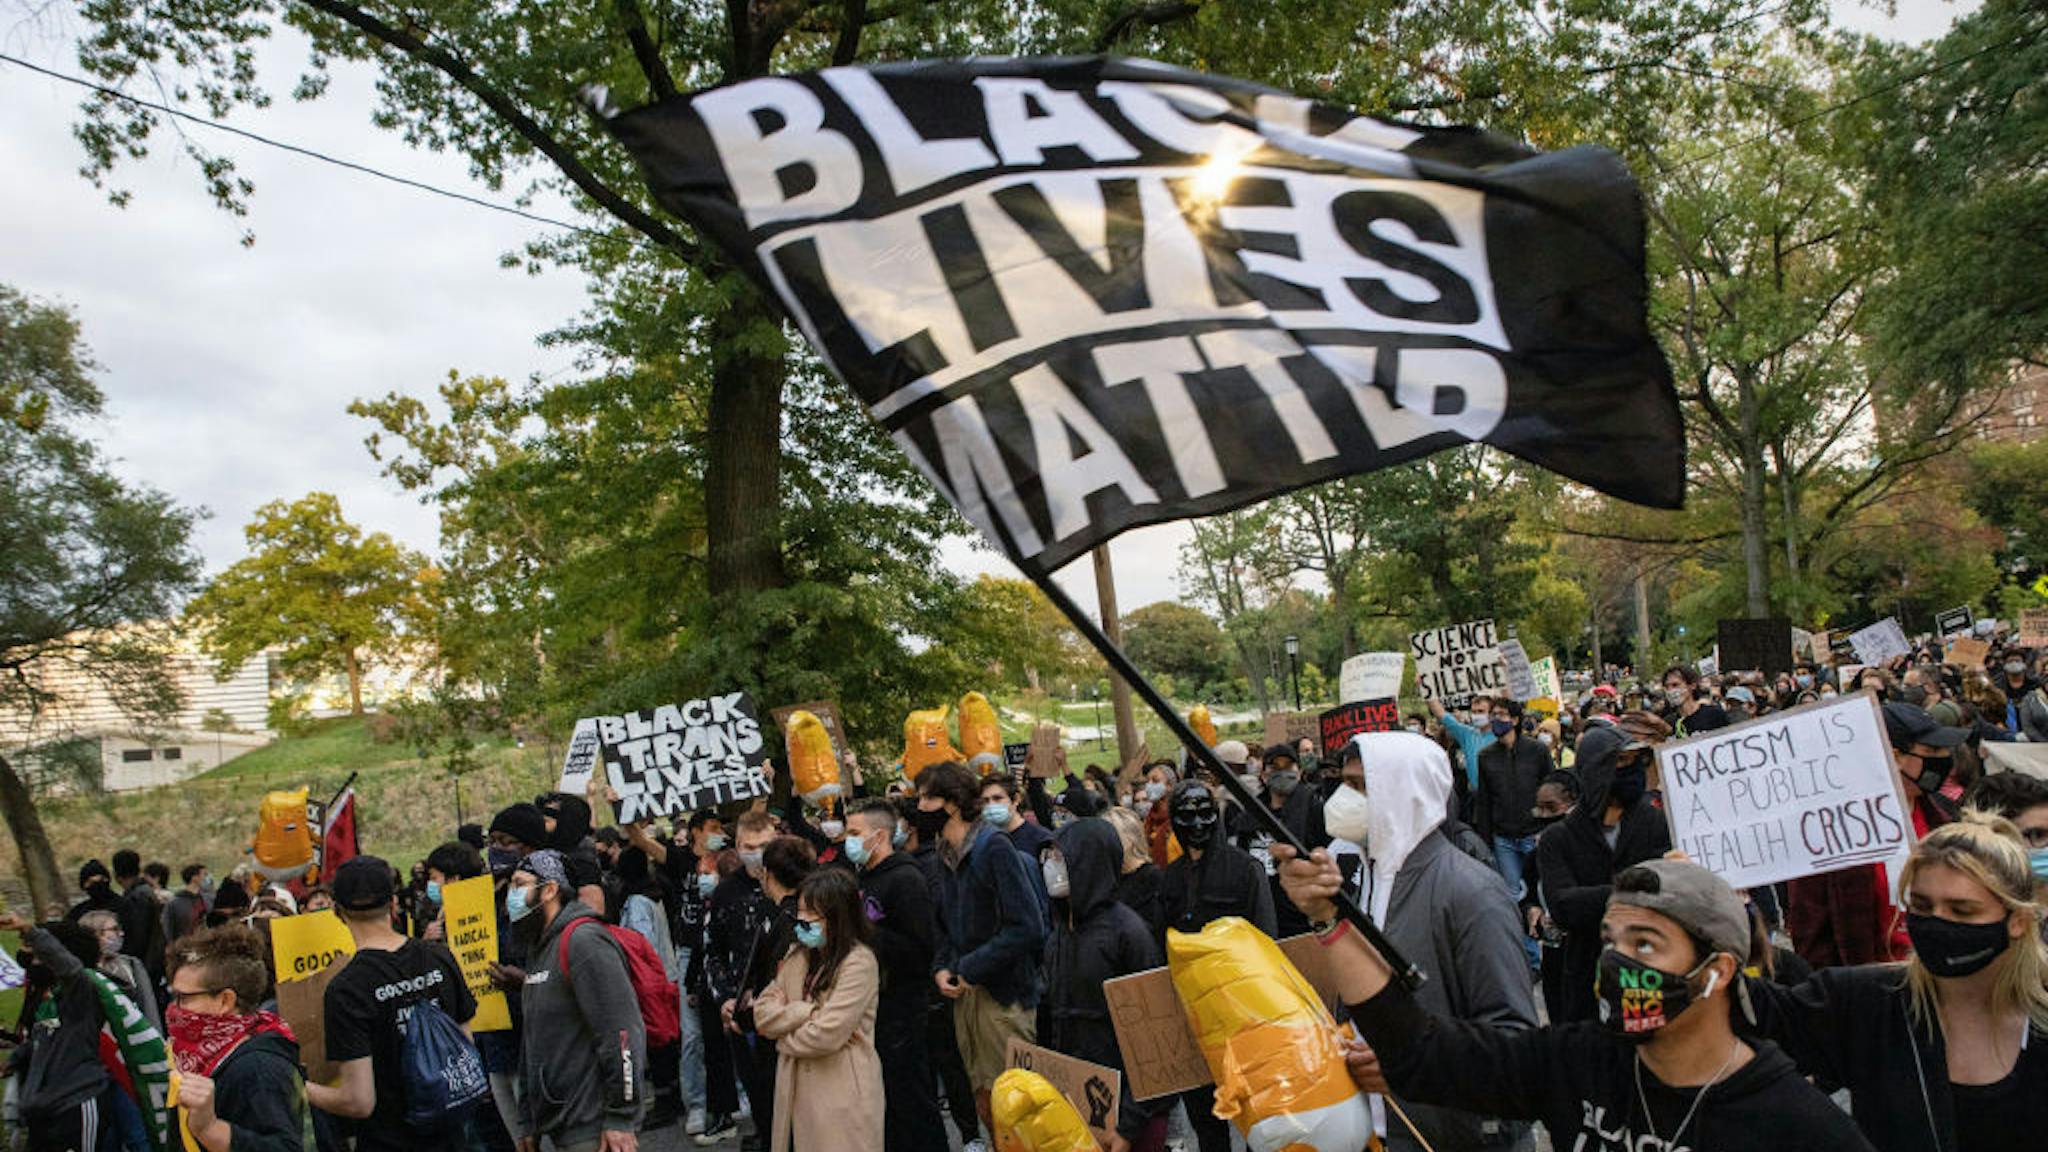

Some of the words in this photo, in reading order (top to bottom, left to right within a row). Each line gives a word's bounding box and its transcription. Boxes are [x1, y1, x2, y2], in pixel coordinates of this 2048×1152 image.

[770, 177, 1482, 394] LIVES
[1411, 621, 1497, 660] SCIENCE
[1440, 650, 1477, 668] NOT
[1420, 663, 1506, 699] SILENCE
[599, 692, 746, 745] BLACK
[1355, 703, 1398, 724] LIVES
[618, 717, 763, 773] TRANS
[1672, 725, 1795, 788] RACISM
[1819, 712, 1855, 747] IS
[607, 754, 747, 800] LIVES
[619, 766, 772, 824] MATTER
[1690, 793, 1713, 827] A
[1728, 754, 1845, 819] PUBLIC
[1682, 817, 1789, 874] HEALTH
[1801, 794, 1903, 855] CRISIS
[454, 927, 490, 947] RADICAL
[1620, 966, 1663, 991] NO
[1622, 998, 1663, 1019] NO
